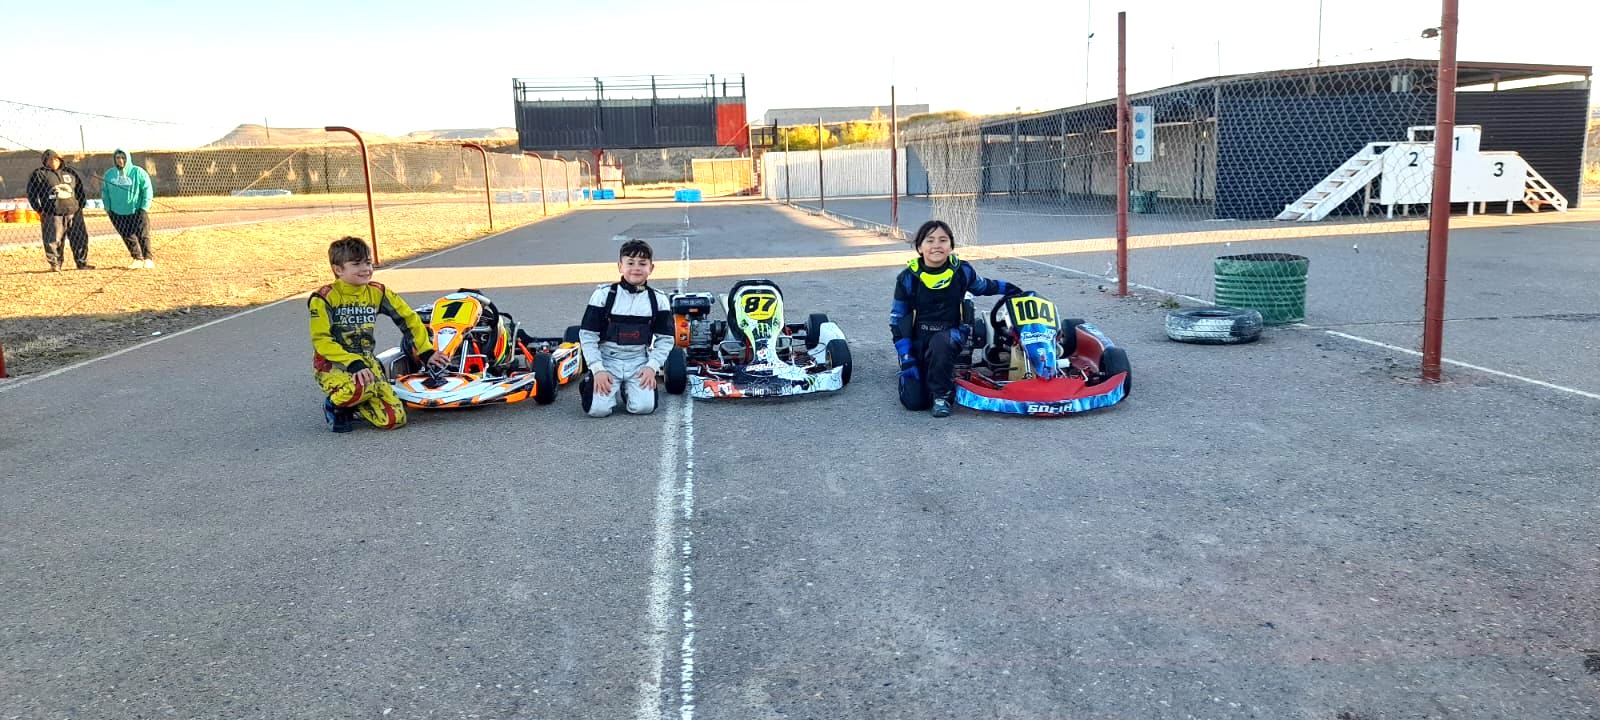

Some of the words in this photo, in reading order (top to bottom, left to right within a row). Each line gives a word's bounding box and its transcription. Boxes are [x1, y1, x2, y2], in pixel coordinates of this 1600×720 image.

[1454, 136, 1460, 151] 1
[1408, 151, 1418, 167] 2
[1493, 161, 1504, 177] 3
[441, 301, 466, 319] 1
[744, 296, 776, 313] 87
[1016, 300, 1054, 322] 104
